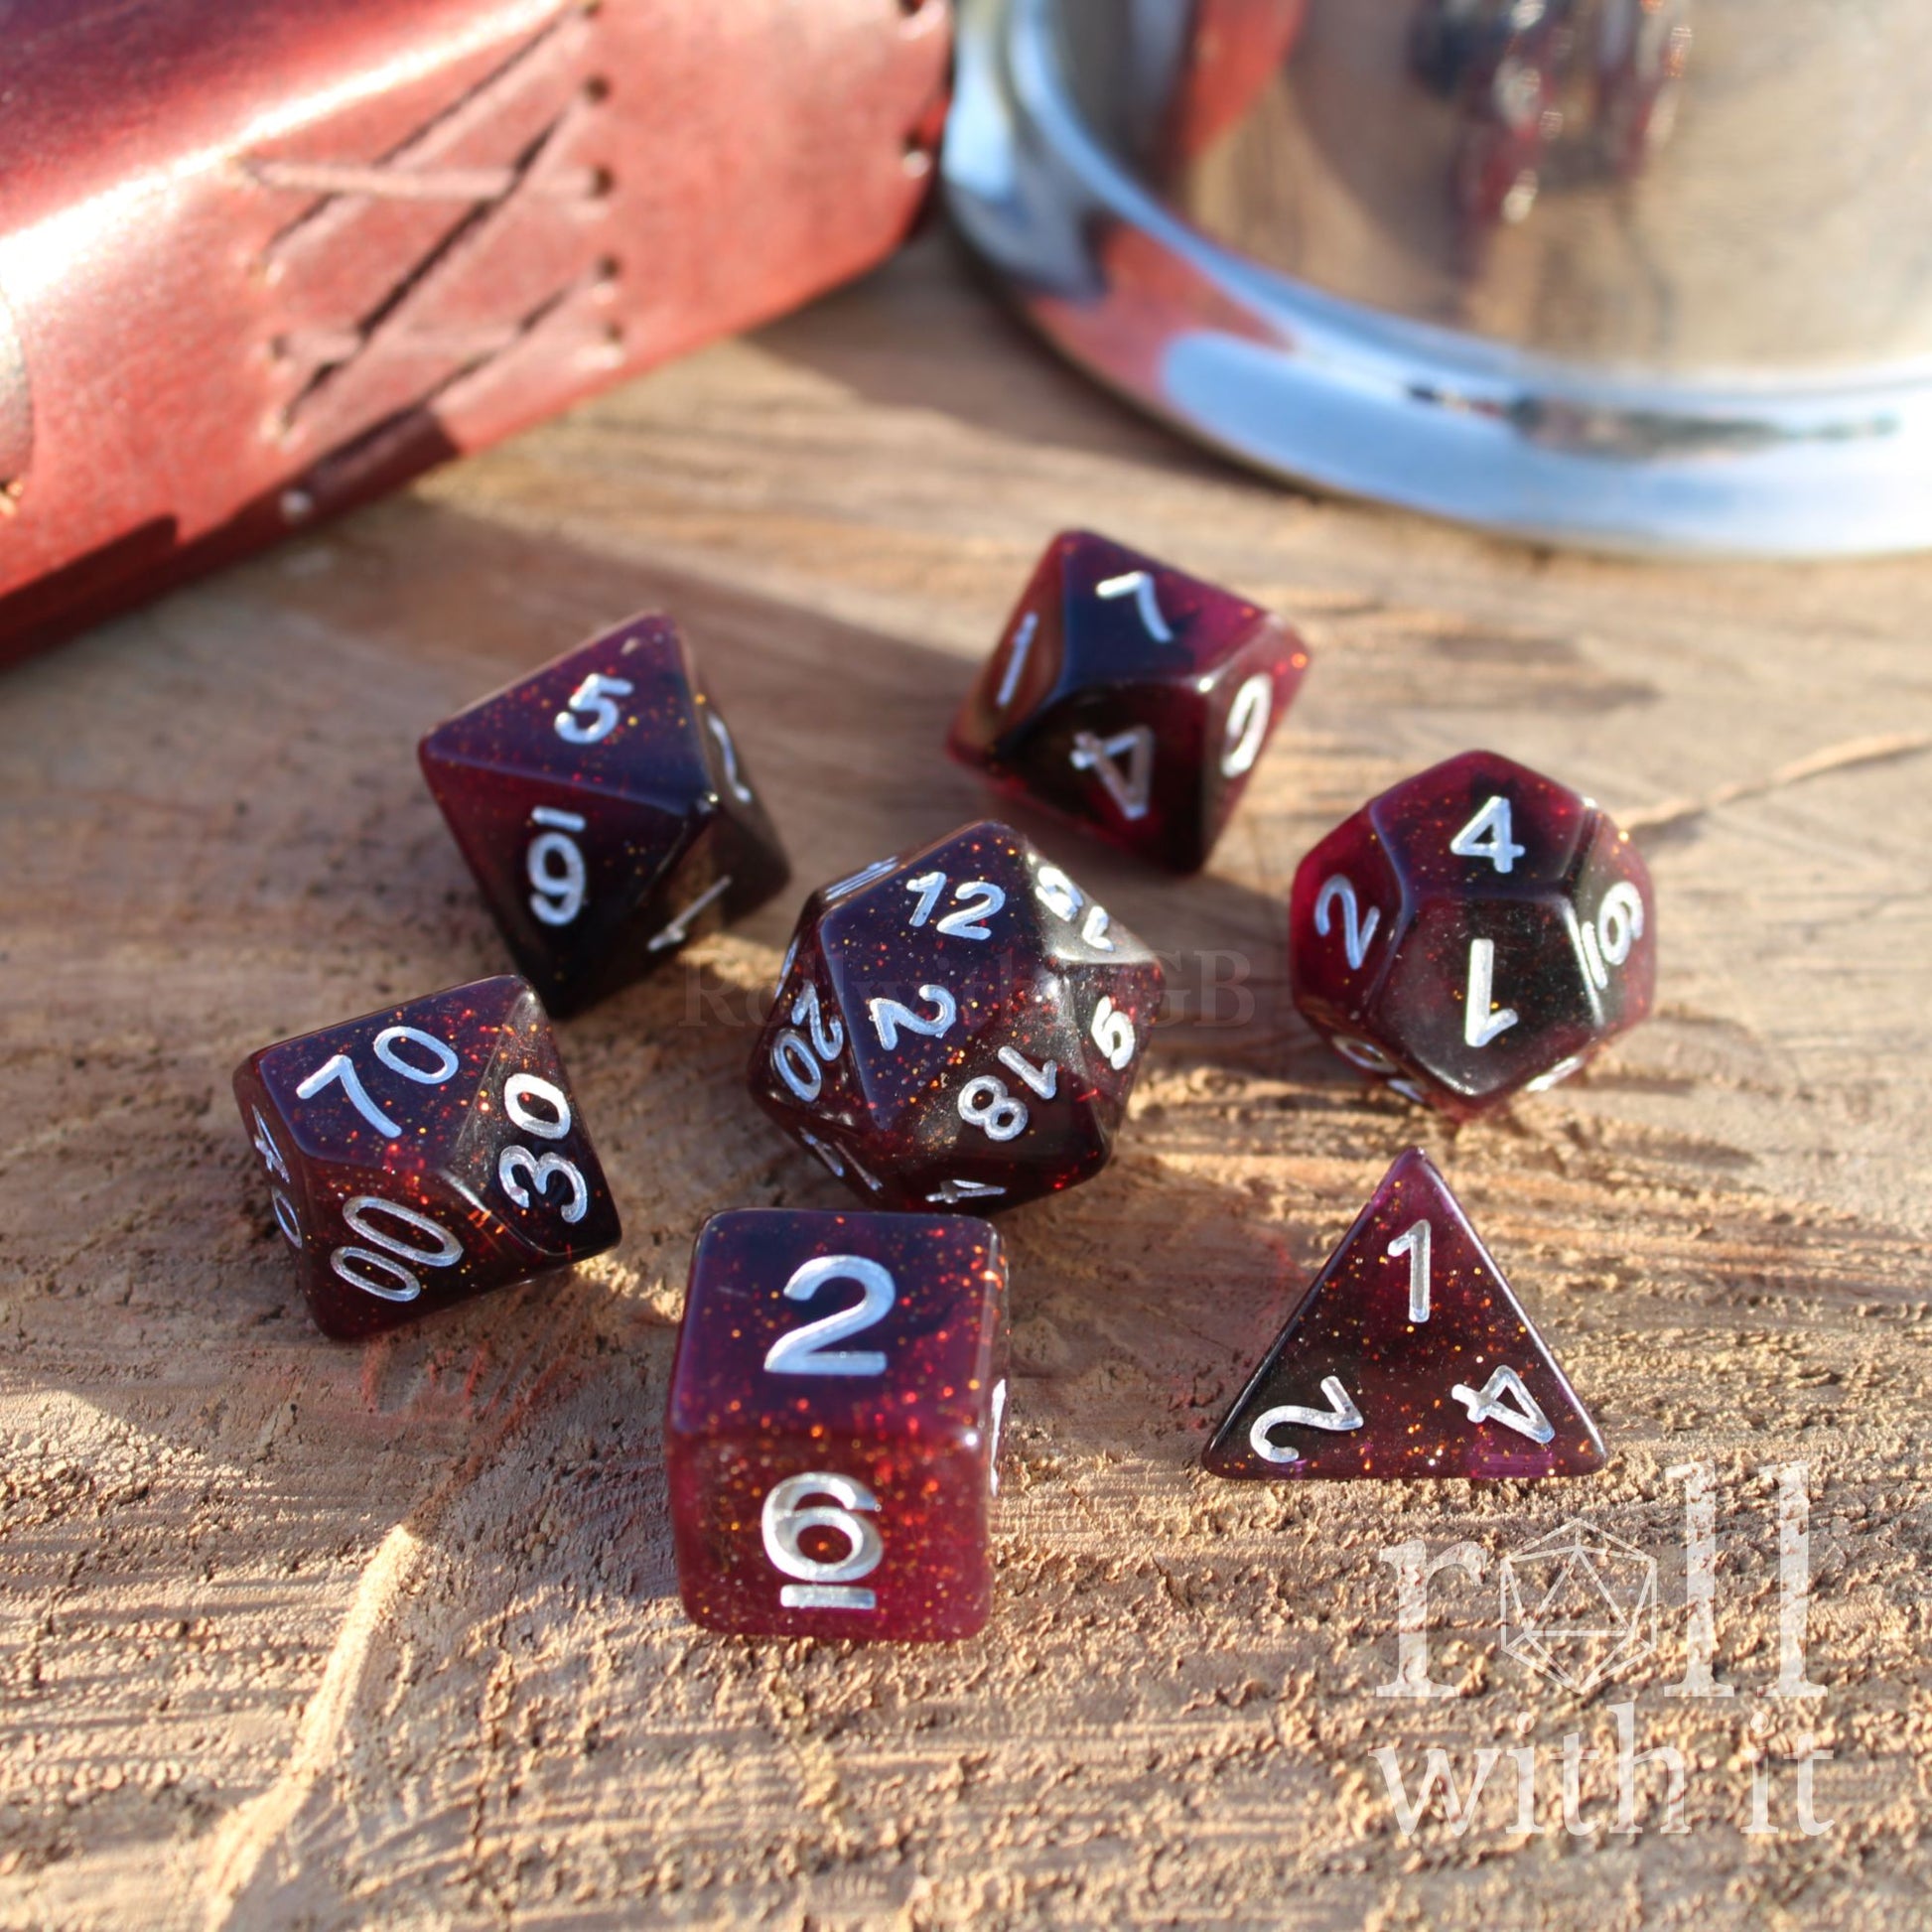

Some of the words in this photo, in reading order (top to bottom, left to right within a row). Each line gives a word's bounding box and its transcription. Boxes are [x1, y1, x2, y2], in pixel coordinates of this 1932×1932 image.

[1095, 570, 1175, 643] 7
[554, 672, 634, 745] 5
[1069, 724, 1155, 821] 4
[1449, 795, 1526, 874] 4
[905, 871, 1007, 942] 12
[1313, 873, 1381, 970] 2
[768, 977, 844, 1103] 20
[869, 983, 958, 1052] 2
[1463, 937, 1519, 1048] 1
[296, 1025, 460, 1140] 70
[957, 1044, 1059, 1143] 18
[497, 1072, 589, 1224] 30
[330, 1194, 465, 1304] 00
[1387, 1218, 1432, 1323] 1
[762, 1253, 897, 1378] 2
[1249, 1374, 1365, 1464] 2
[1450, 1364, 1556, 1445] 4
